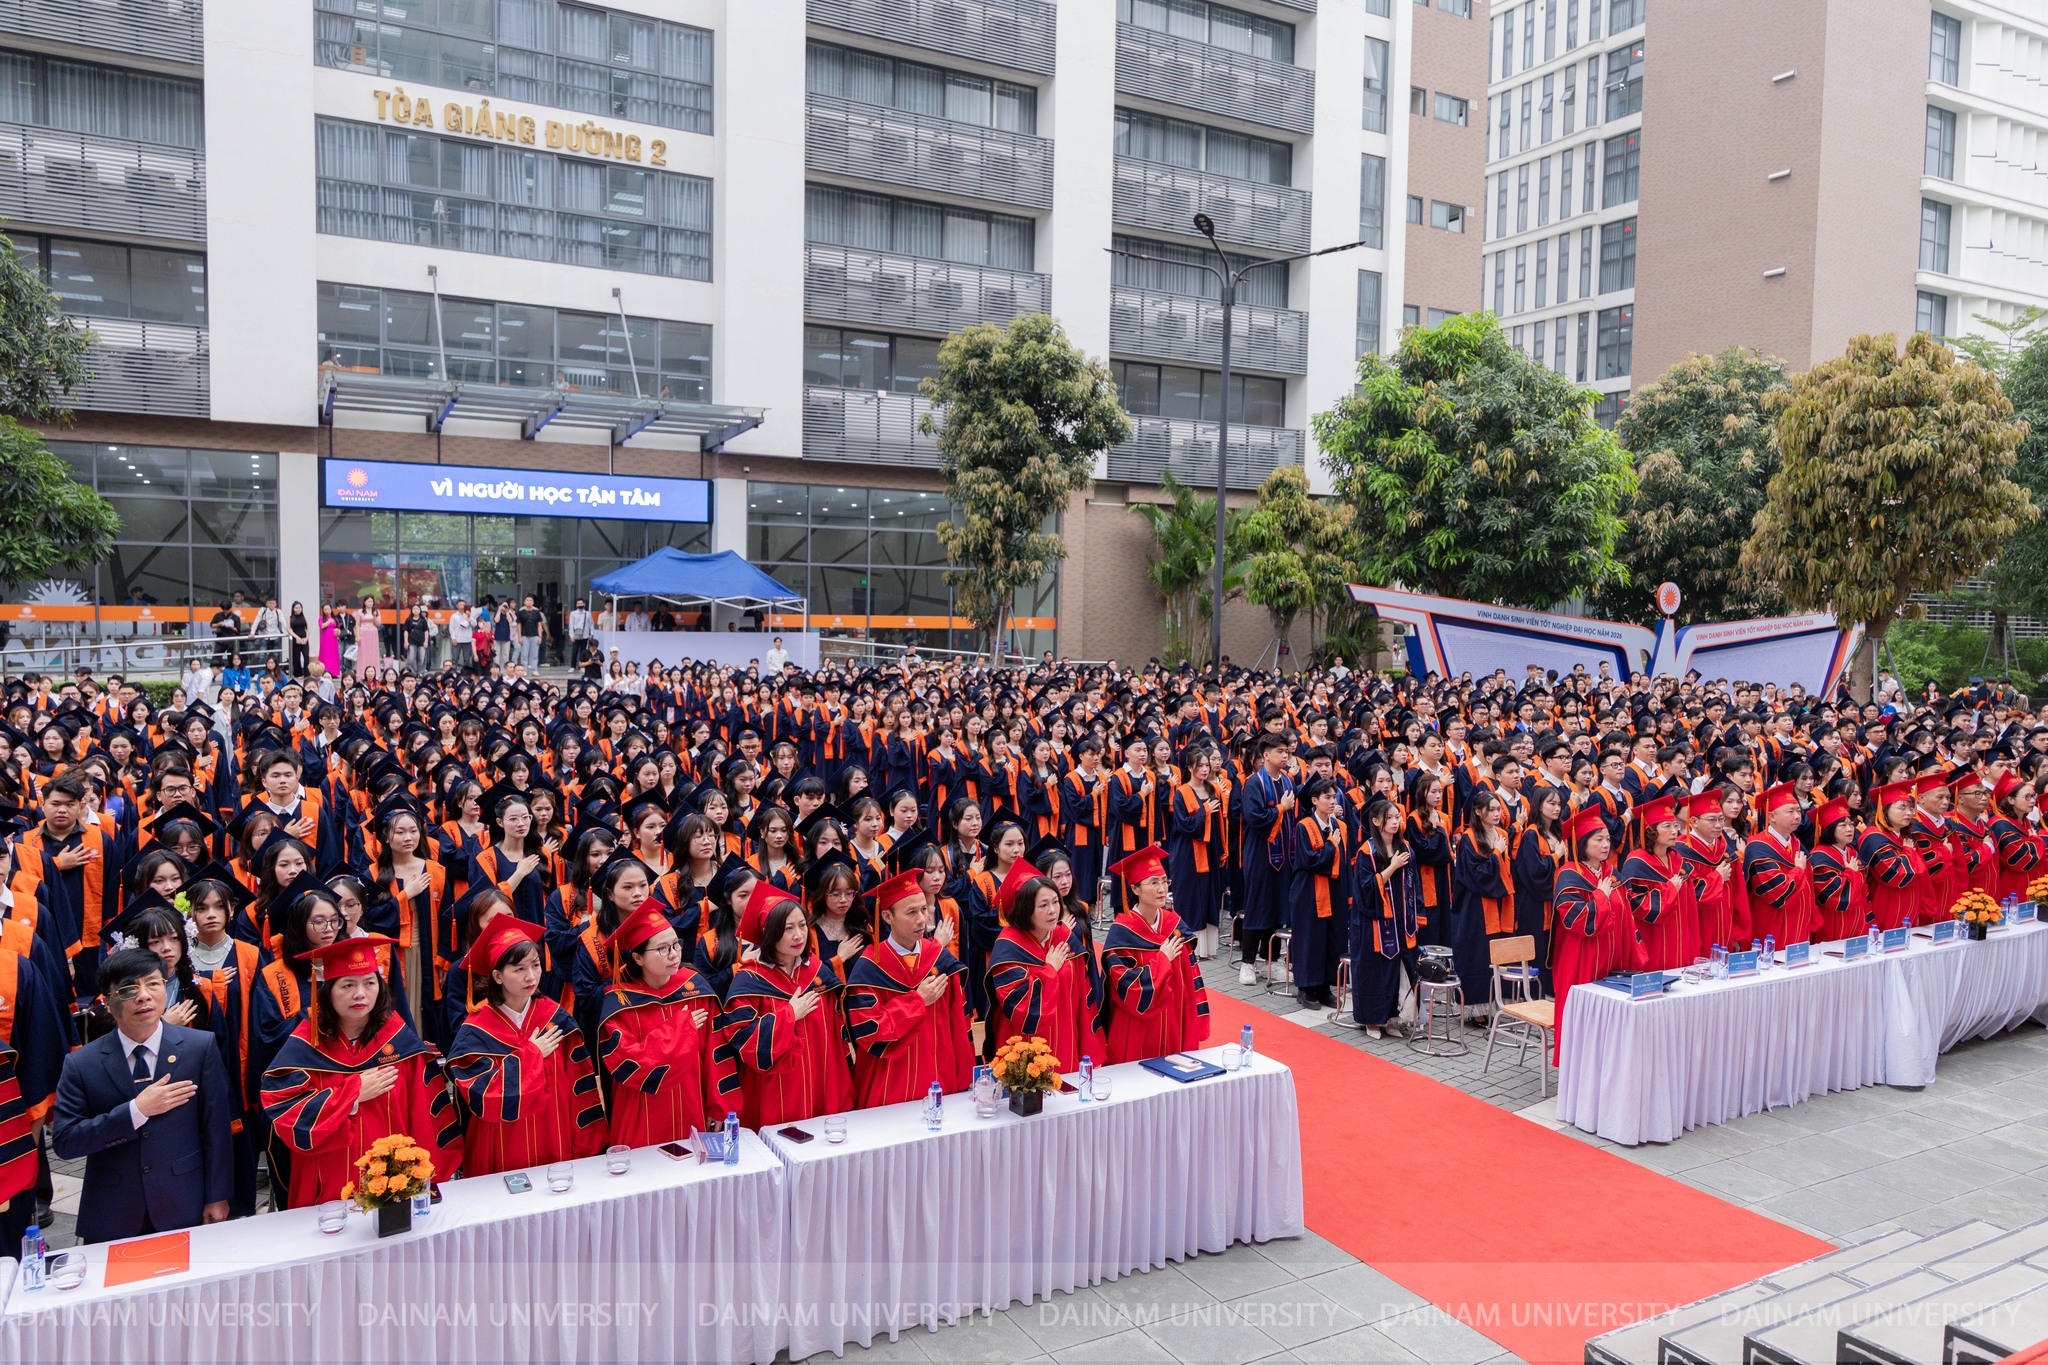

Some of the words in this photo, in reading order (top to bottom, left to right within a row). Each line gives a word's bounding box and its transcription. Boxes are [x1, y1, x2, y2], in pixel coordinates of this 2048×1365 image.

[373, 86, 433, 128] TÒA
[444, 98, 536, 144] GIẢNG
[545, 120, 642, 161] ĐƯỜNG
[650, 139, 667, 166] 2
[356, 489, 378, 497] NAM
[431, 478, 453, 497] VÌ
[458, 481, 525, 500] NGƯỜI
[529, 485, 573, 505] HỌC
[576, 485, 616, 507] TẬN
[620, 487, 661, 506] TÂM
[1477, 610, 1492, 619] VINH
[1493, 612, 1510, 621] DANH
[1511, 615, 1525, 624] SINH
[1525, 617, 1539, 627] VIÊN
[1552, 621, 1573, 633] NGHIỆP
[1573, 625, 1583, 635] ĐẠI
[1583, 627, 1596, 637] HỌC
[592, 935, 610, 978] UNIVERSITY
[275, 970, 291, 1014] UNIVERSITY
